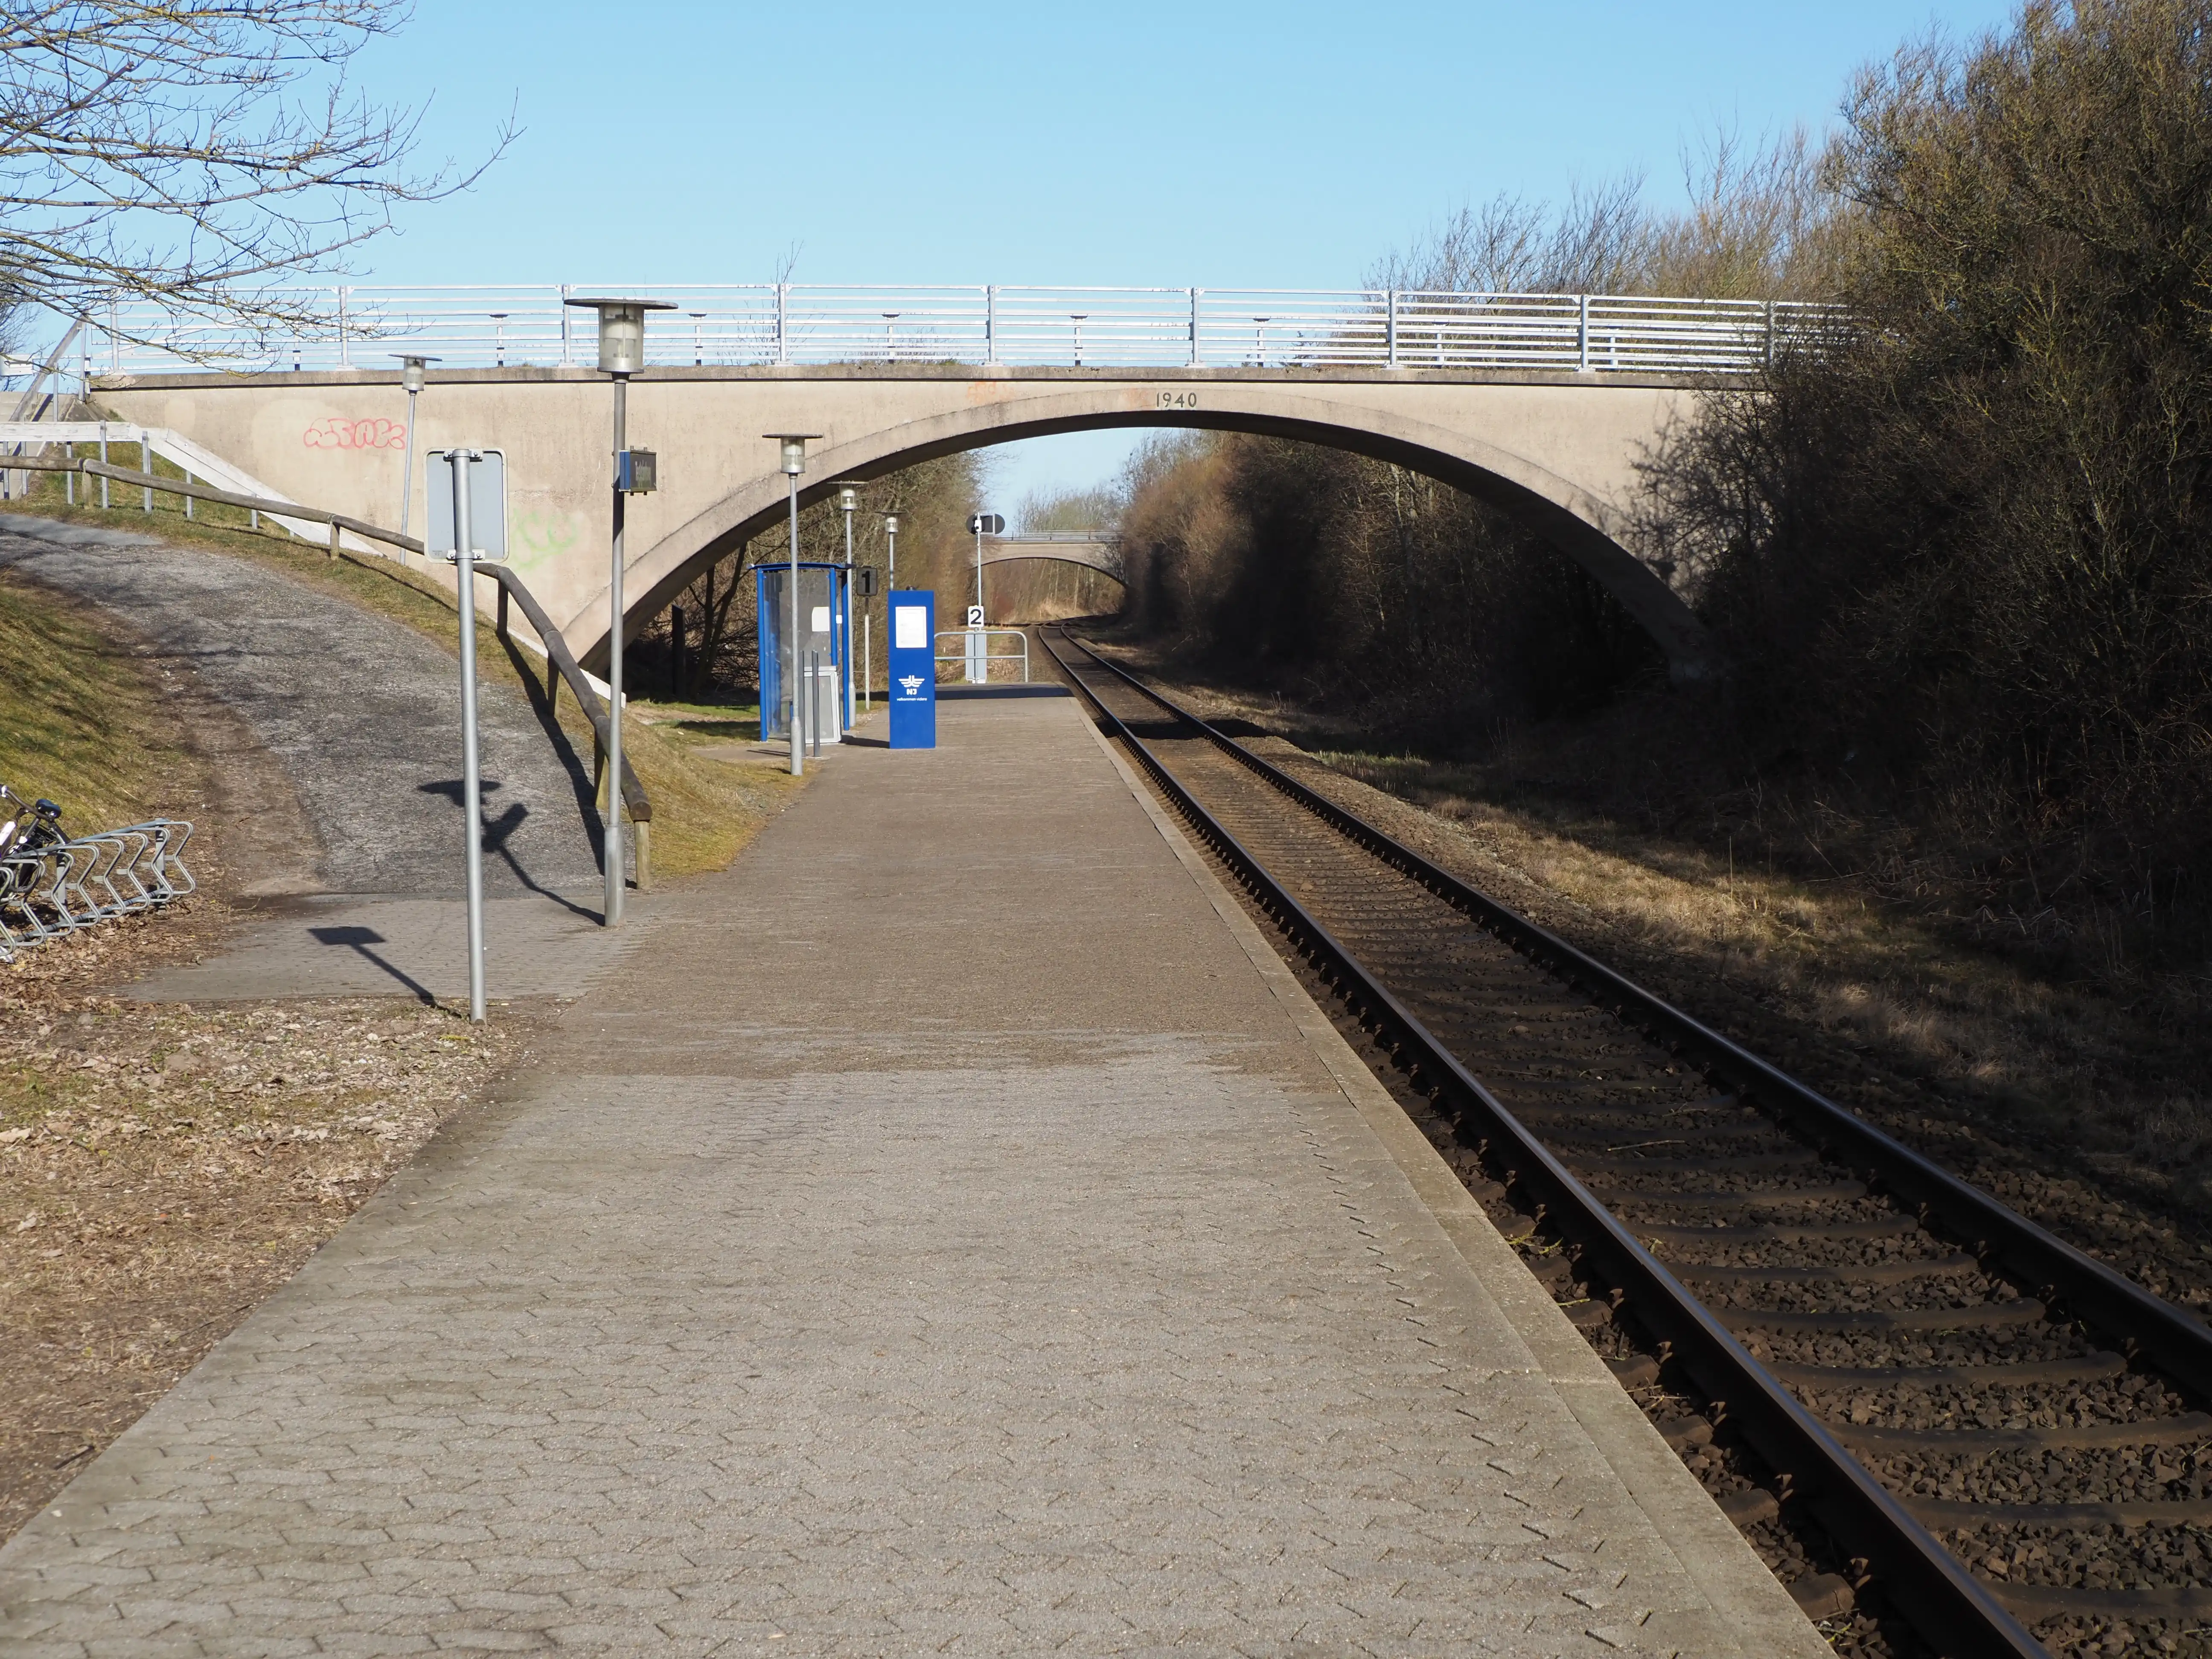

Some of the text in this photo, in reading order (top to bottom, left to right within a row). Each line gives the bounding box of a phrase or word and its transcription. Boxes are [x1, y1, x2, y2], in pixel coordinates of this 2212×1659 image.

[1157, 392, 1197, 407] 1940
[862, 571, 870, 593] 1
[970, 608, 981, 624] 2
